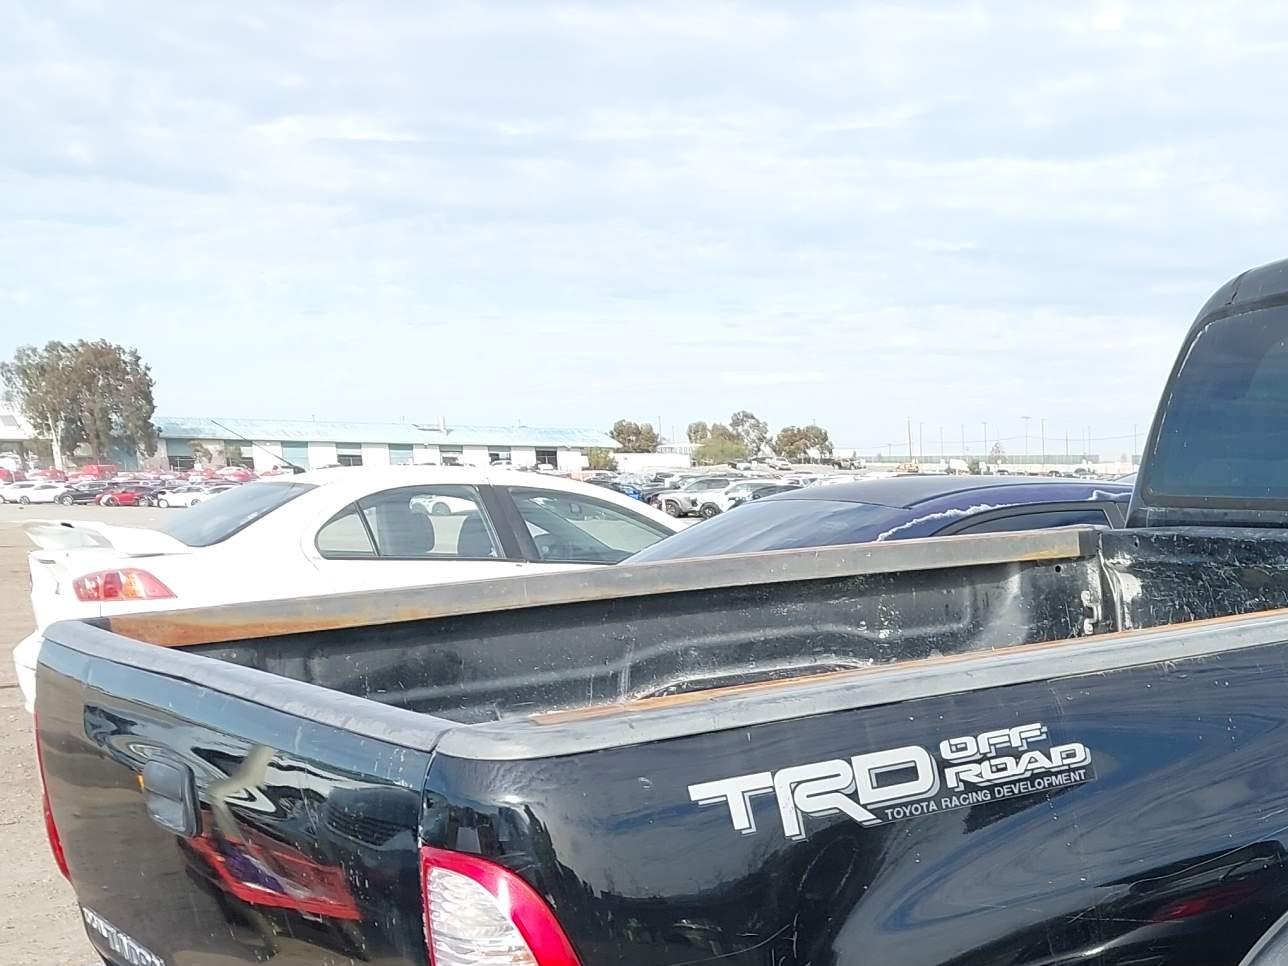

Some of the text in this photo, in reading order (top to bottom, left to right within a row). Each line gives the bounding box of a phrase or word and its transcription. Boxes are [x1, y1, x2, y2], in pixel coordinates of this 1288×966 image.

[939, 722, 1048, 763] OFF
[944, 742, 1092, 791] ROAD
[687, 745, 941, 841] TRD
[885, 768, 1087, 820] TOYOTA RACING DEVELOPMENT
